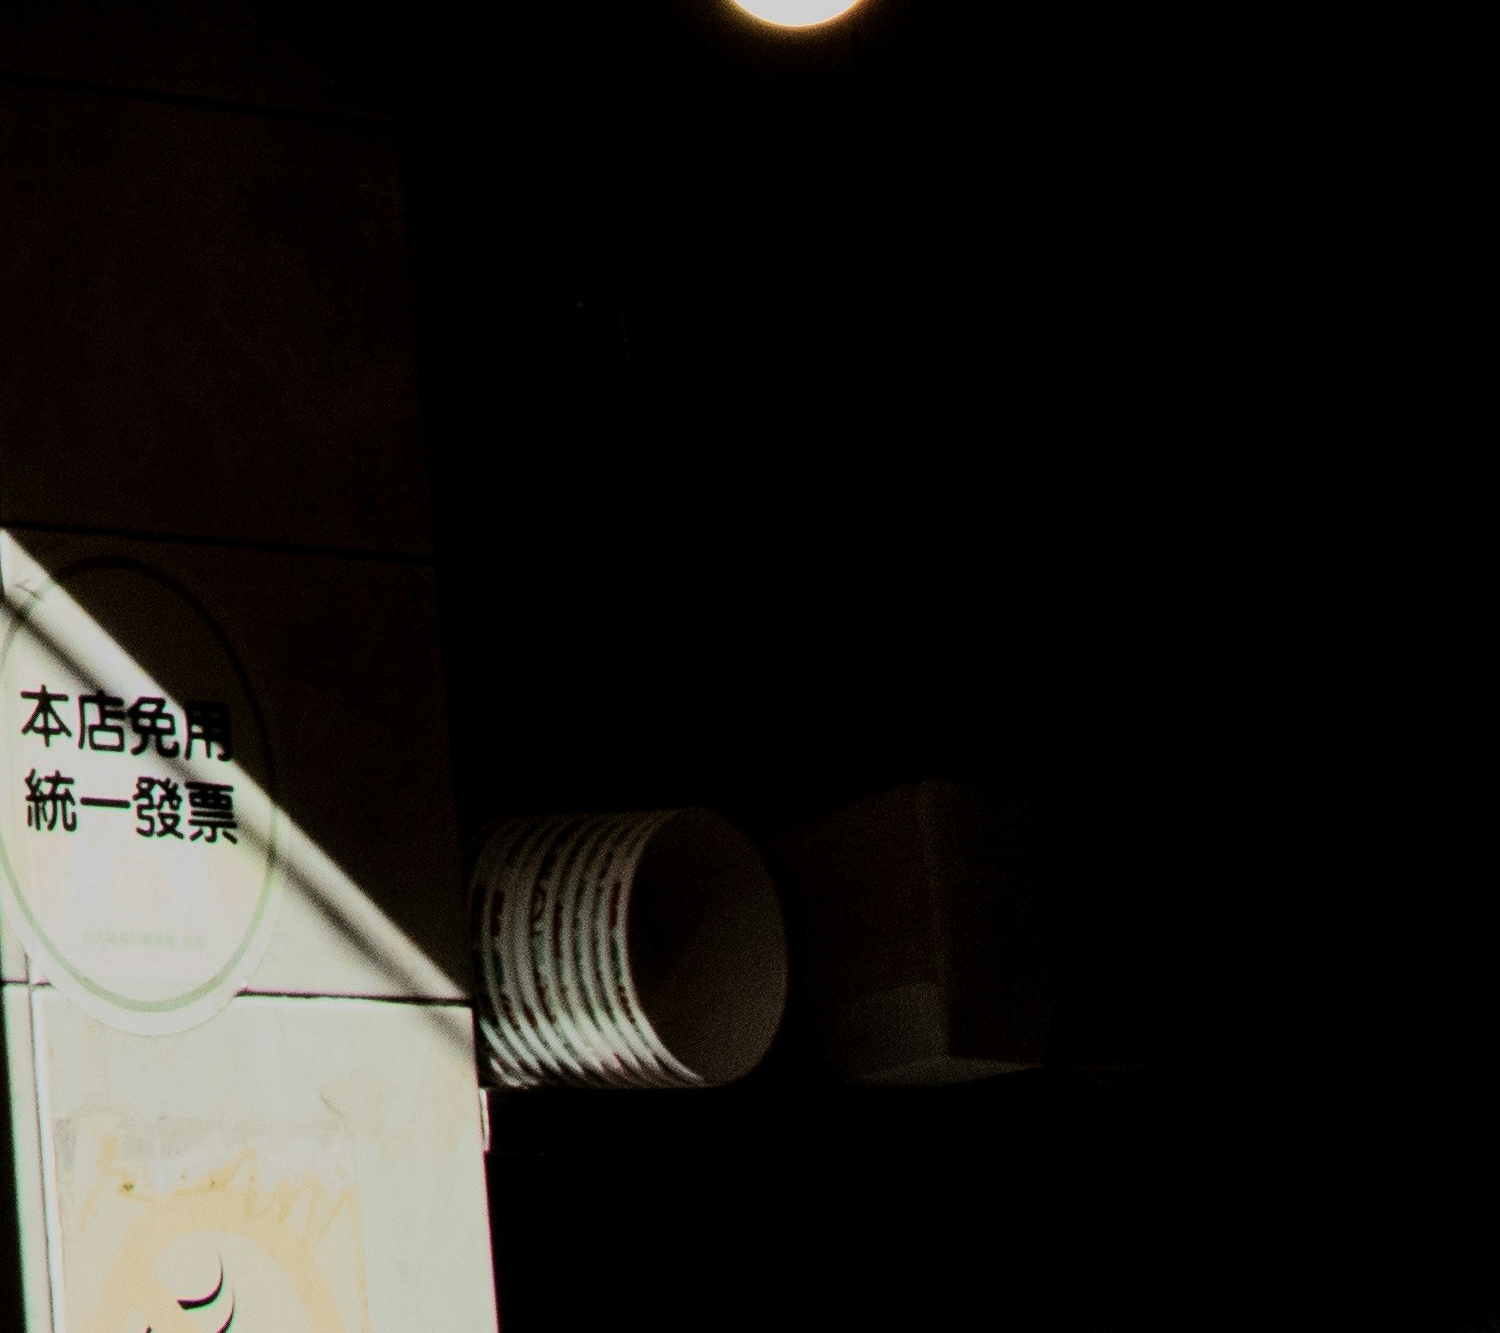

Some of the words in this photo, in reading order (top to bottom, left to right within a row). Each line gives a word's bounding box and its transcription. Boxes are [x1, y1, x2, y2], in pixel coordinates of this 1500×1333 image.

[20, 684, 232, 762] 本店免用
[24, 768, 238, 845] 統一發票
